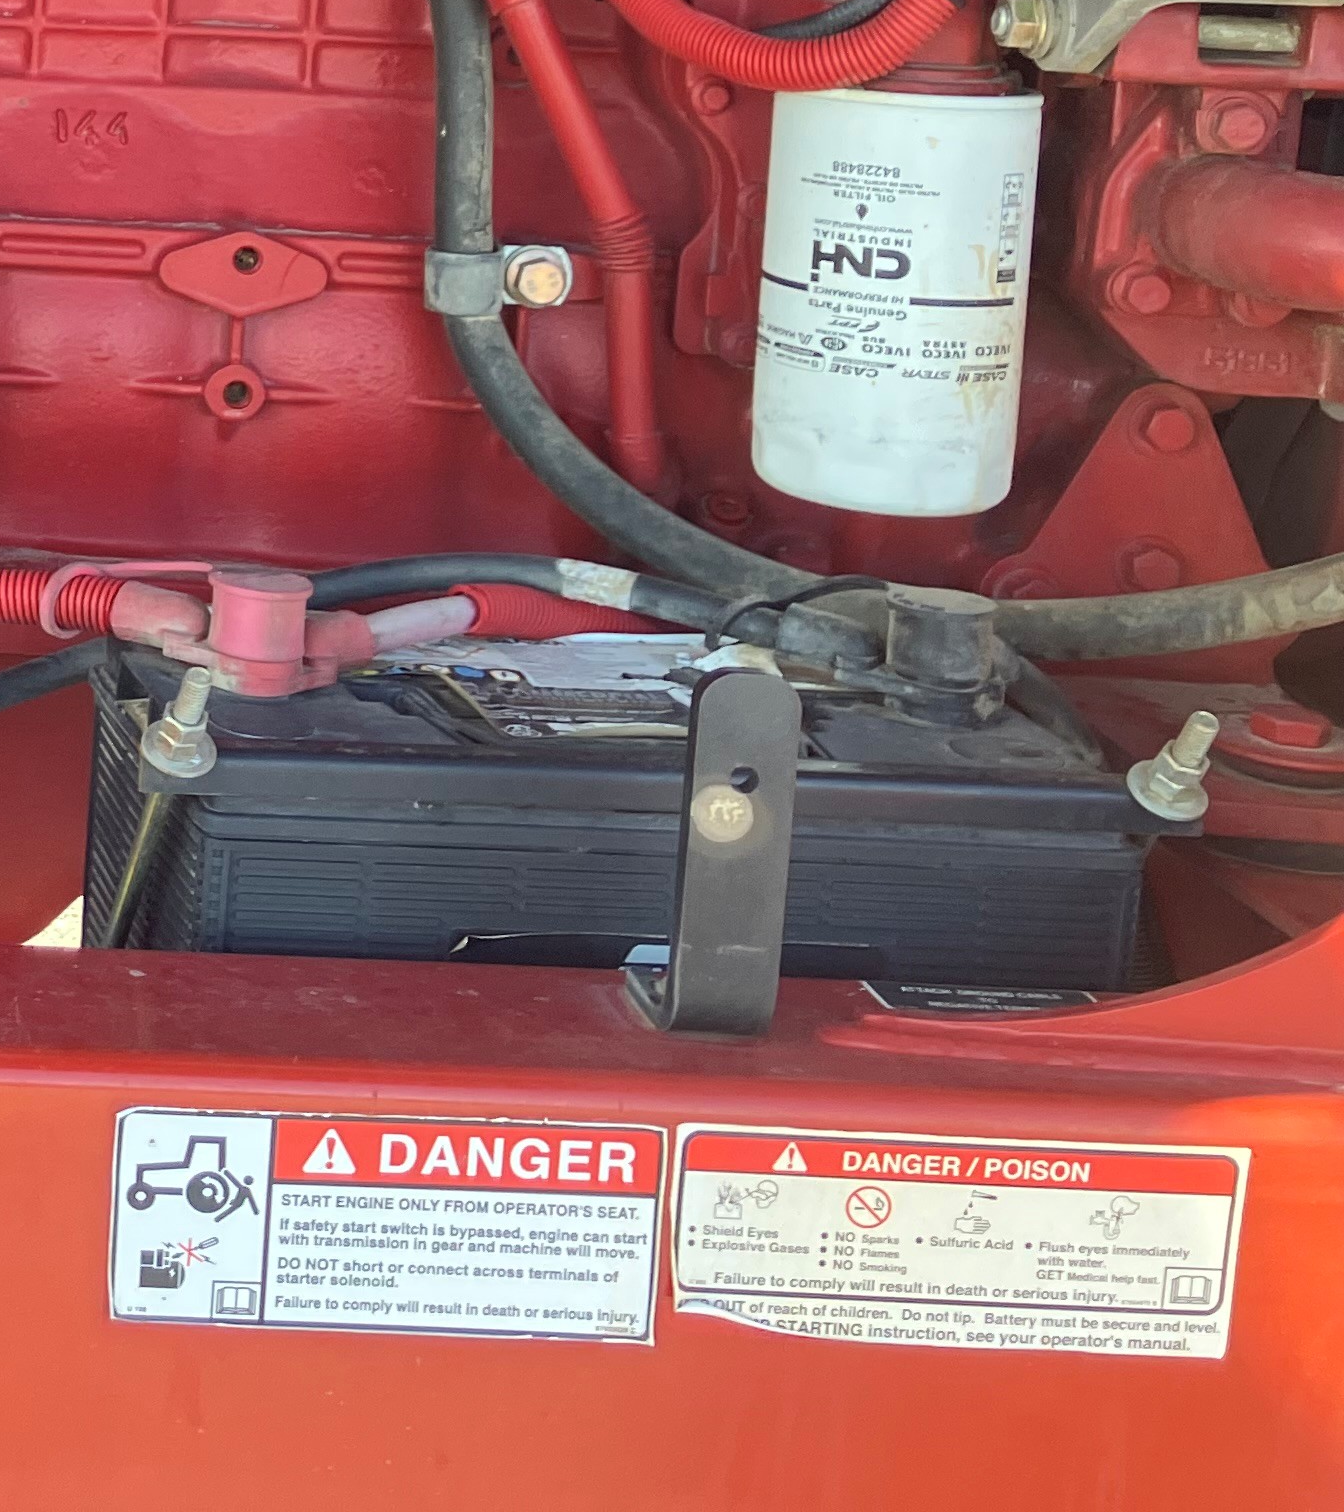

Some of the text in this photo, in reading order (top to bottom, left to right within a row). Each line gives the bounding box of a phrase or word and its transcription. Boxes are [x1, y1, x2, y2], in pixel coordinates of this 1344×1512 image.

[875, 194, 896, 203] OIL
[813, 228, 912, 248] INDUSTRIAL
[813, 286, 889, 303] PERFORMANCE
[808, 298, 907, 321] Genuine Parts
[861, 344, 911, 357] IVECO
[922, 349, 966, 359] IVECO
[975, 344, 1011, 356] IVECO
[828, 363, 879, 378] CASE
[901, 369, 951, 380] STEYR
[973, 371, 1007, 383] CASE
[378, 1133, 637, 1183] DANGER
[842, 1150, 1091, 1183] DANGER / POISON
[281, 1193, 639, 1220] START ENGINE ONLY FROM OPERATOR'S SEAT.
[279, 1217, 647, 1245] If safety start switch is bypassed, engine can start
[702, 1224, 779, 1240] Shield Eyes
[834, 1231, 855, 1242] NO
[278, 1233, 639, 1259] with transmission in gear and machine will move.
[701, 1238, 809, 1254] Explosive Gases
[929, 1235, 1013, 1250] Sulfuric Acid
[1038, 1240, 1190, 1261] Flush eyes immediately
[833, 1245, 854, 1257] NO
[277, 1256, 619, 1282] DO NOT short or connect across terminals of
[832, 1259, 853, 1270] NO
[1036, 1255, 1106, 1268] with water.
[276, 1272, 398, 1288] starter solenoid.
[1035, 1269, 1065, 1280] GET
[713, 1271, 766, 1286] Failure
[770, 1275, 785, 1287] to
[789, 1277, 845, 1292] comply
[849, 1278, 875, 1291] will
[879, 1281, 923, 1294] result
[926, 1281, 941, 1294] in
[944, 1283, 987, 1296] death
[991, 1288, 1009, 1297] or
[1012, 1287, 1068, 1300] serious
[1072, 1288, 1118, 1305] injury.
[274, 1295, 639, 1325] Failure to comply will result in death or serious injury.
[749, 1301, 764, 1313] of
[767, 1303, 807, 1315] reach
[812, 1304, 827, 1316] of
[830, 1305, 893, 1319] children.
[901, 1308, 921, 1321] Do
[925, 1311, 949, 1322] not
[953, 1311, 975, 1325] tip.
[984, 1312, 1037, 1328] Battery
[1040, 1317, 1076, 1328] must
[1080, 1316, 1099, 1329] be
[1102, 1320, 1150, 1331] secure
[1153, 1320, 1181, 1332] and
[1184, 1320, 1219, 1333] level.
[774, 1319, 862, 1336] STARTING
[867, 1323, 960, 1342] instruction,
[966, 1331, 995, 1343] see
[998, 1332, 1037, 1345] your
[1040, 1334, 1122, 1348] operator's
[1127, 1338, 1190, 1351] manual.
